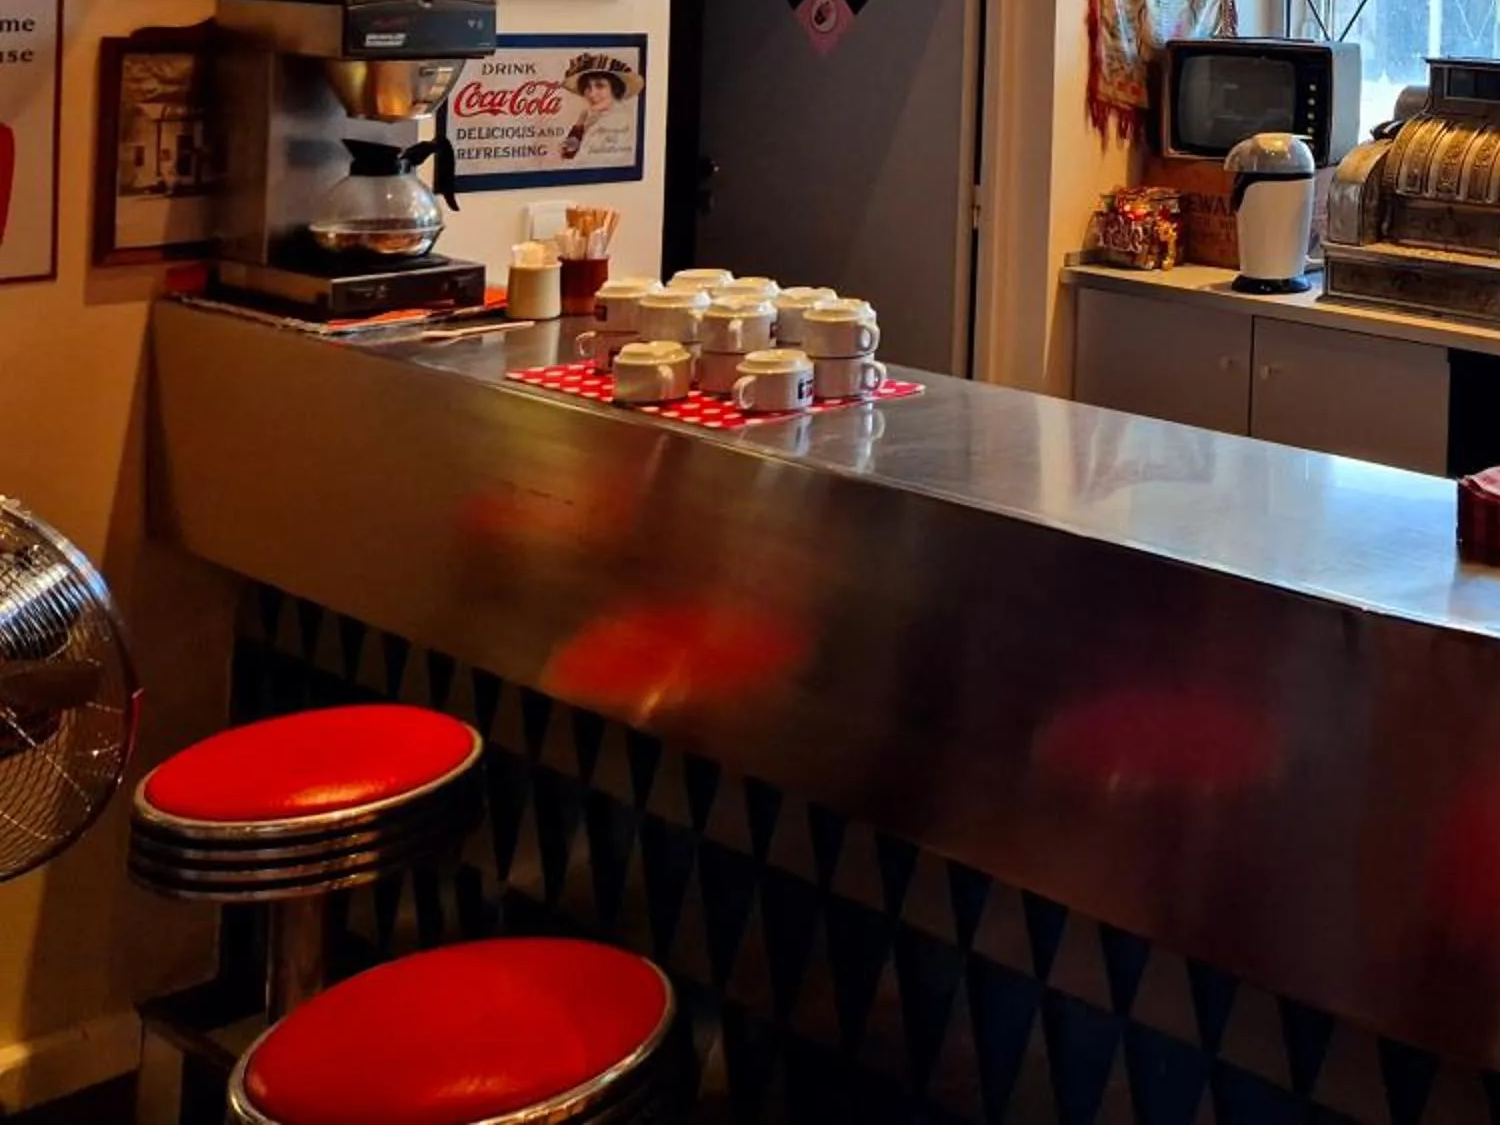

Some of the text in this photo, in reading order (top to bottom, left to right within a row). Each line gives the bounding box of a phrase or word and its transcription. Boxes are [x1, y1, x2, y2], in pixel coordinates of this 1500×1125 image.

[482, 62, 537, 76] DRINK
[453, 79, 565, 118] Coca-Cola
[455, 126, 565, 141] DELICIOUS AND
[456, 144, 549, 161] REFRESHING
